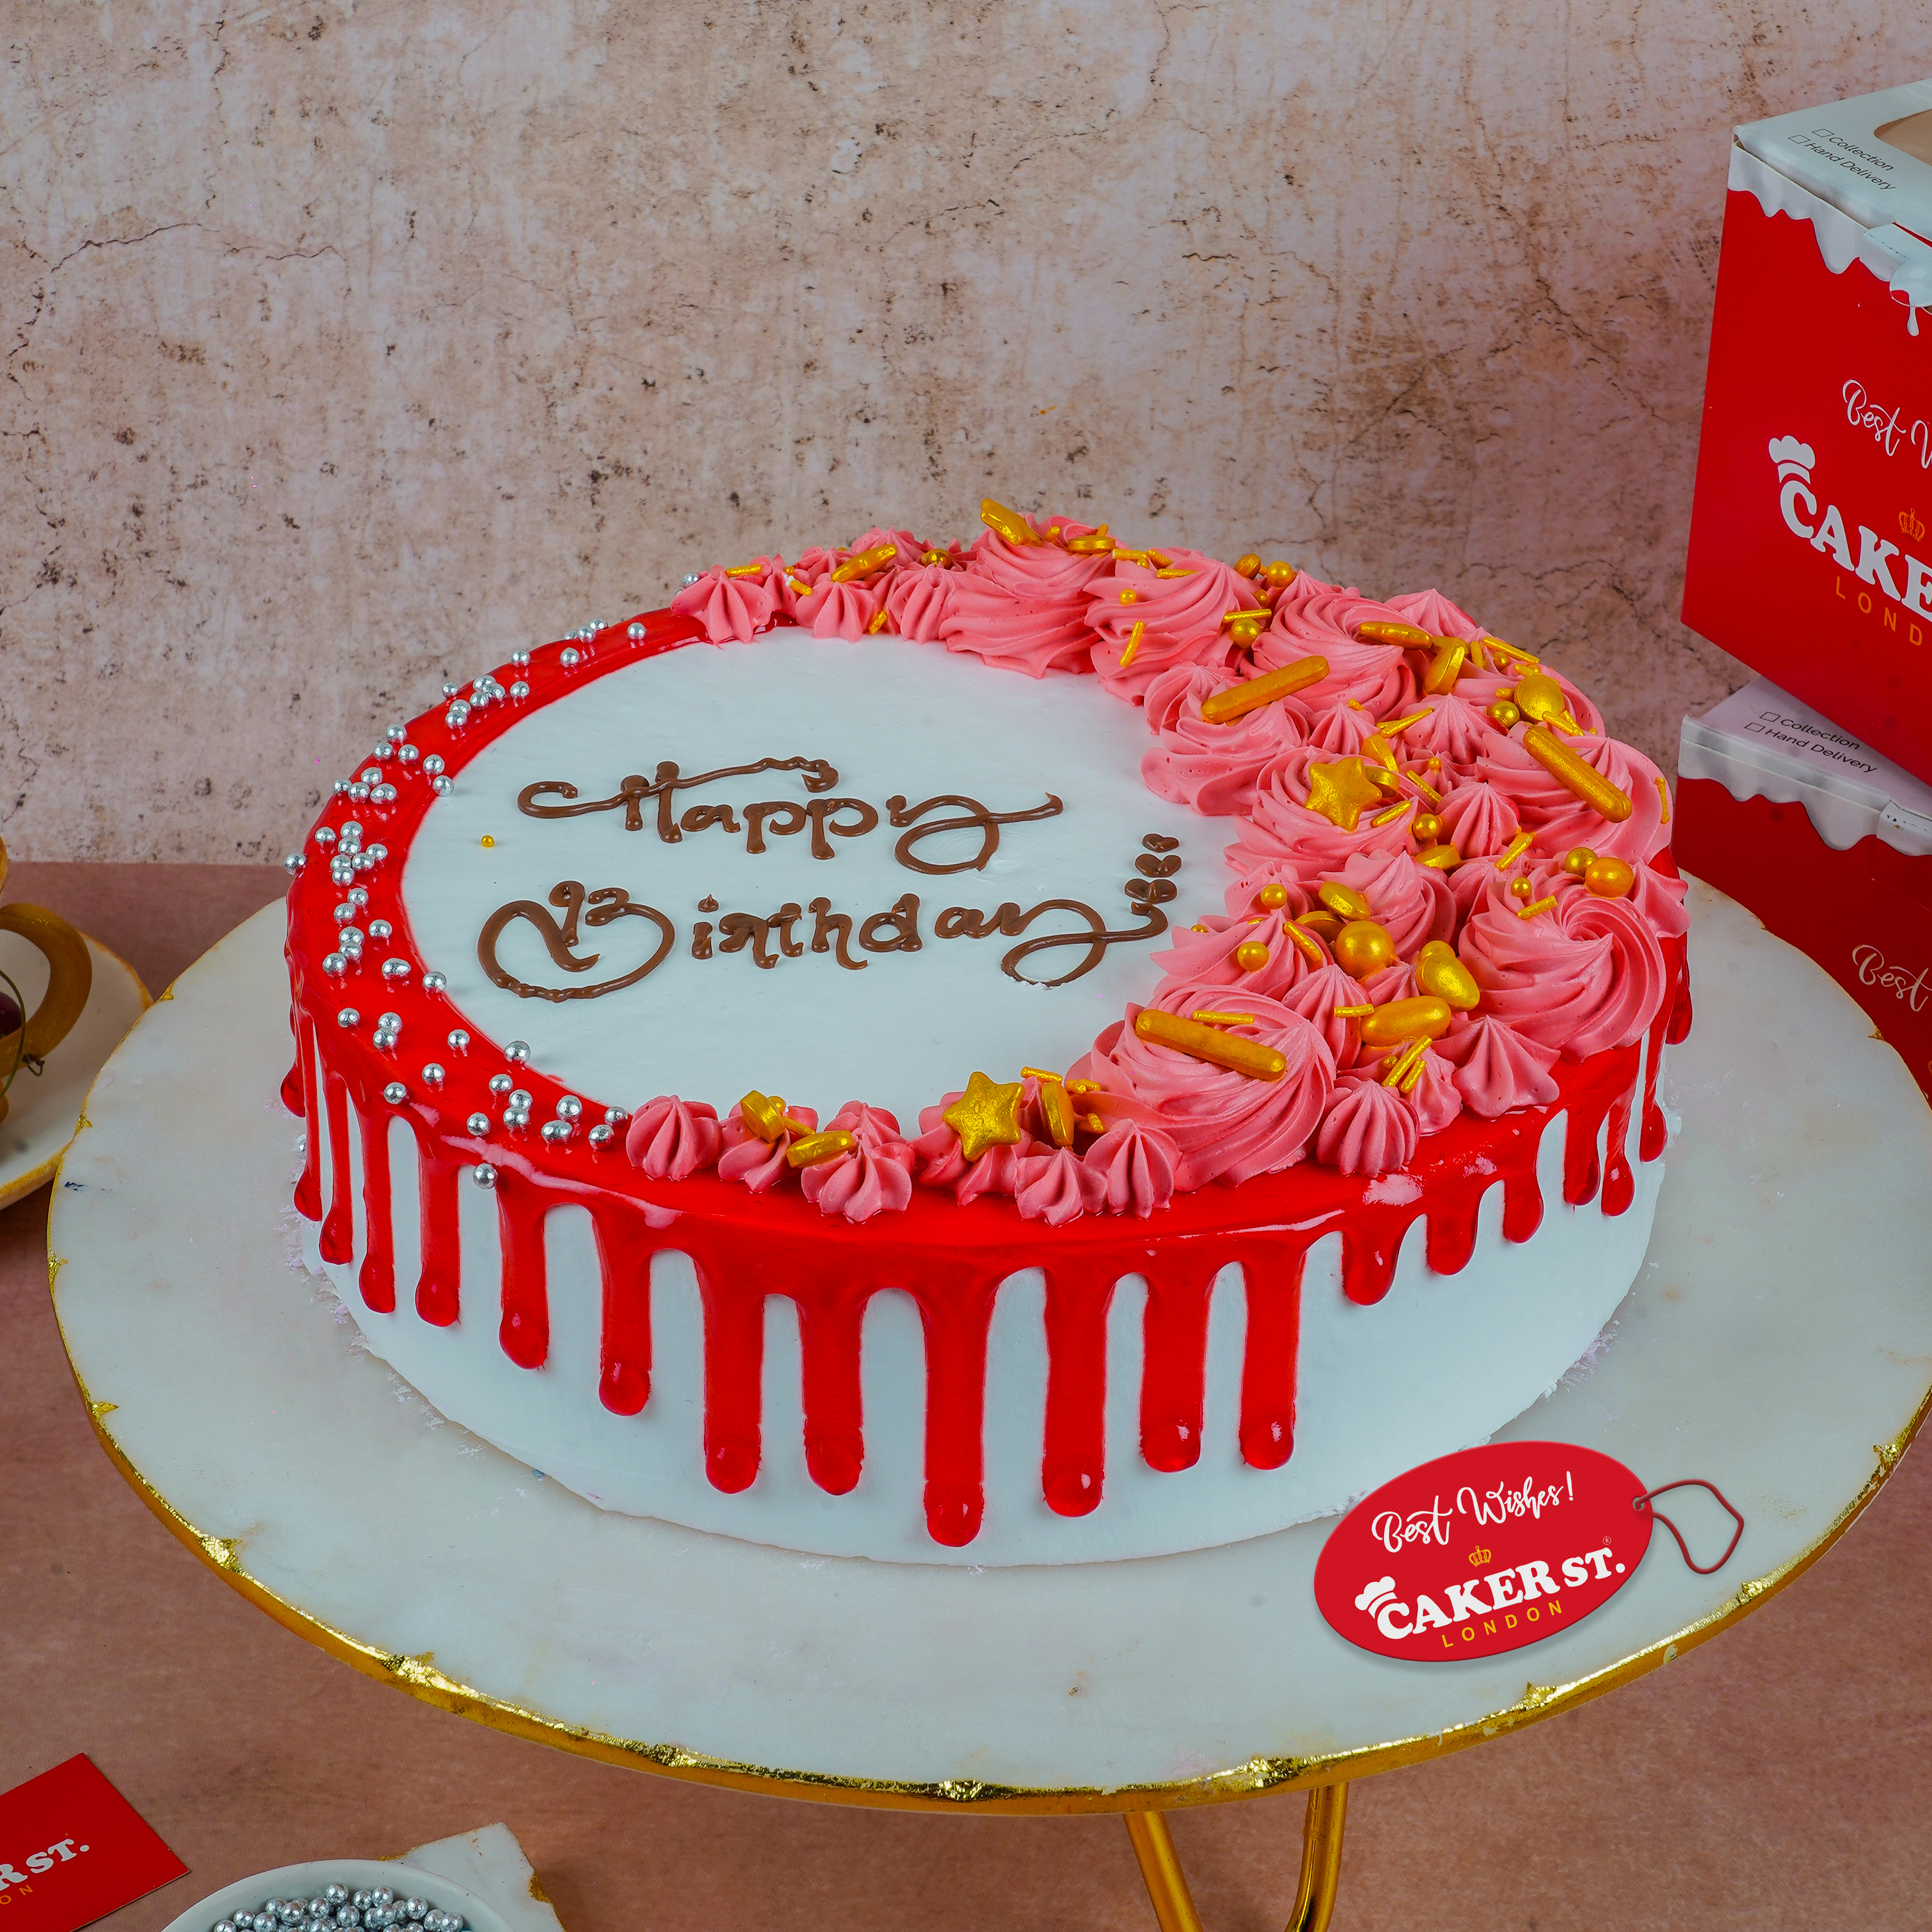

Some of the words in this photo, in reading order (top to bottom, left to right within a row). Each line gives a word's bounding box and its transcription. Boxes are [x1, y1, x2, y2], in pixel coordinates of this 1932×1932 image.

[1805, 143, 1845, 162] Hand
[1840, 161, 1896, 190] Delivery
[1829, 137, 1894, 171] Collection
[1842, 379, 1907, 457] Best
[1765, 729, 1810, 748] Hand
[1810, 744, 1878, 773] Delivery
[1780, 719, 1860, 750] Collection
[518, 757, 1064, 875] Happy
[1852, 944, 1932, 1012] Best
[26, 1838, 90, 1874] ST.
